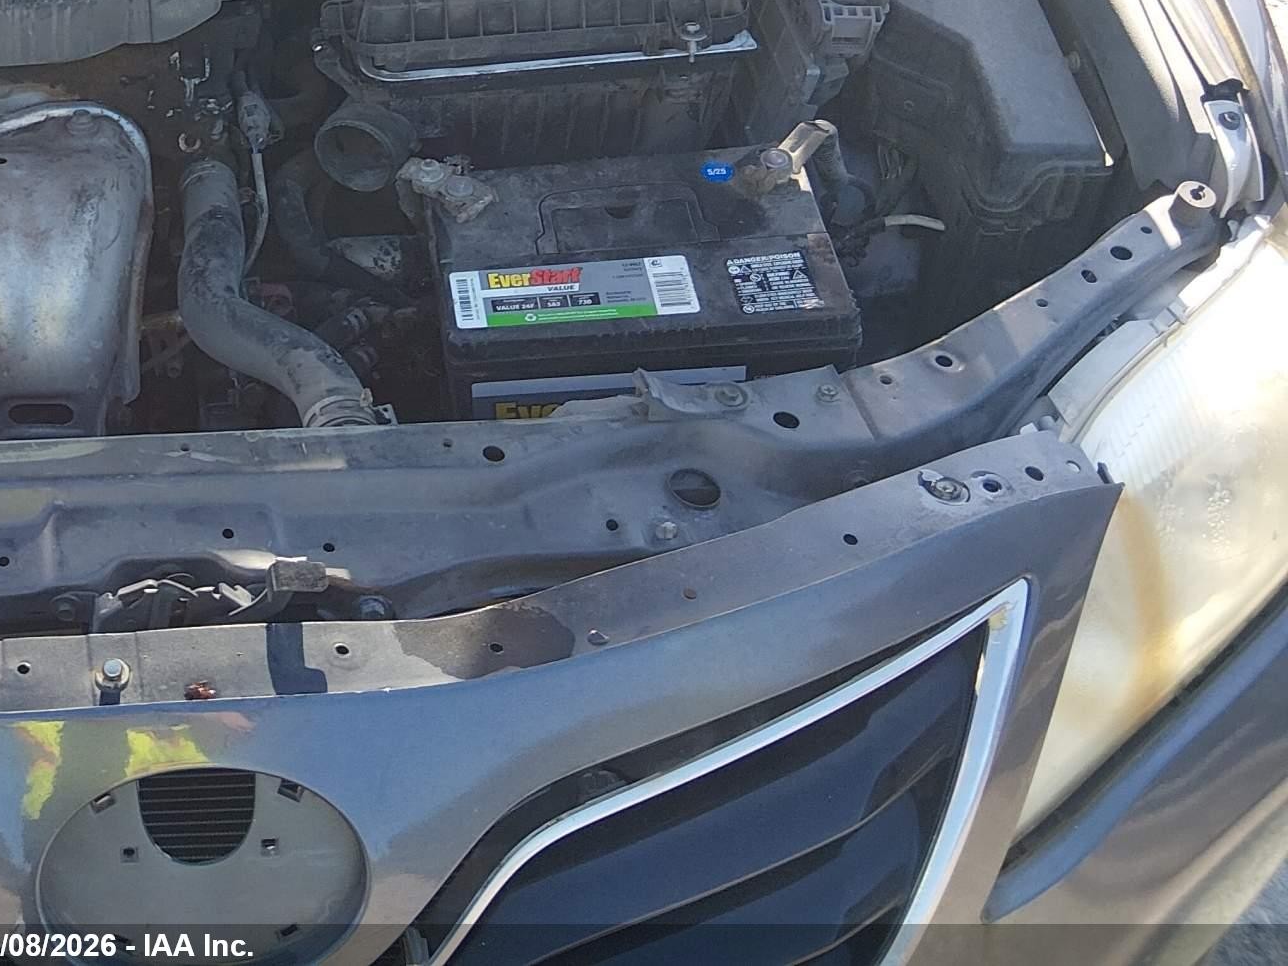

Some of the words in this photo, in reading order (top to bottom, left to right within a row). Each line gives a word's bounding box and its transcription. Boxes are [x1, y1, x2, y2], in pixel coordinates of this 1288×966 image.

[488, 267, 581, 289] EverStart
[547, 284, 577, 292] VALUE
[496, 302, 520, 311] VALUE
